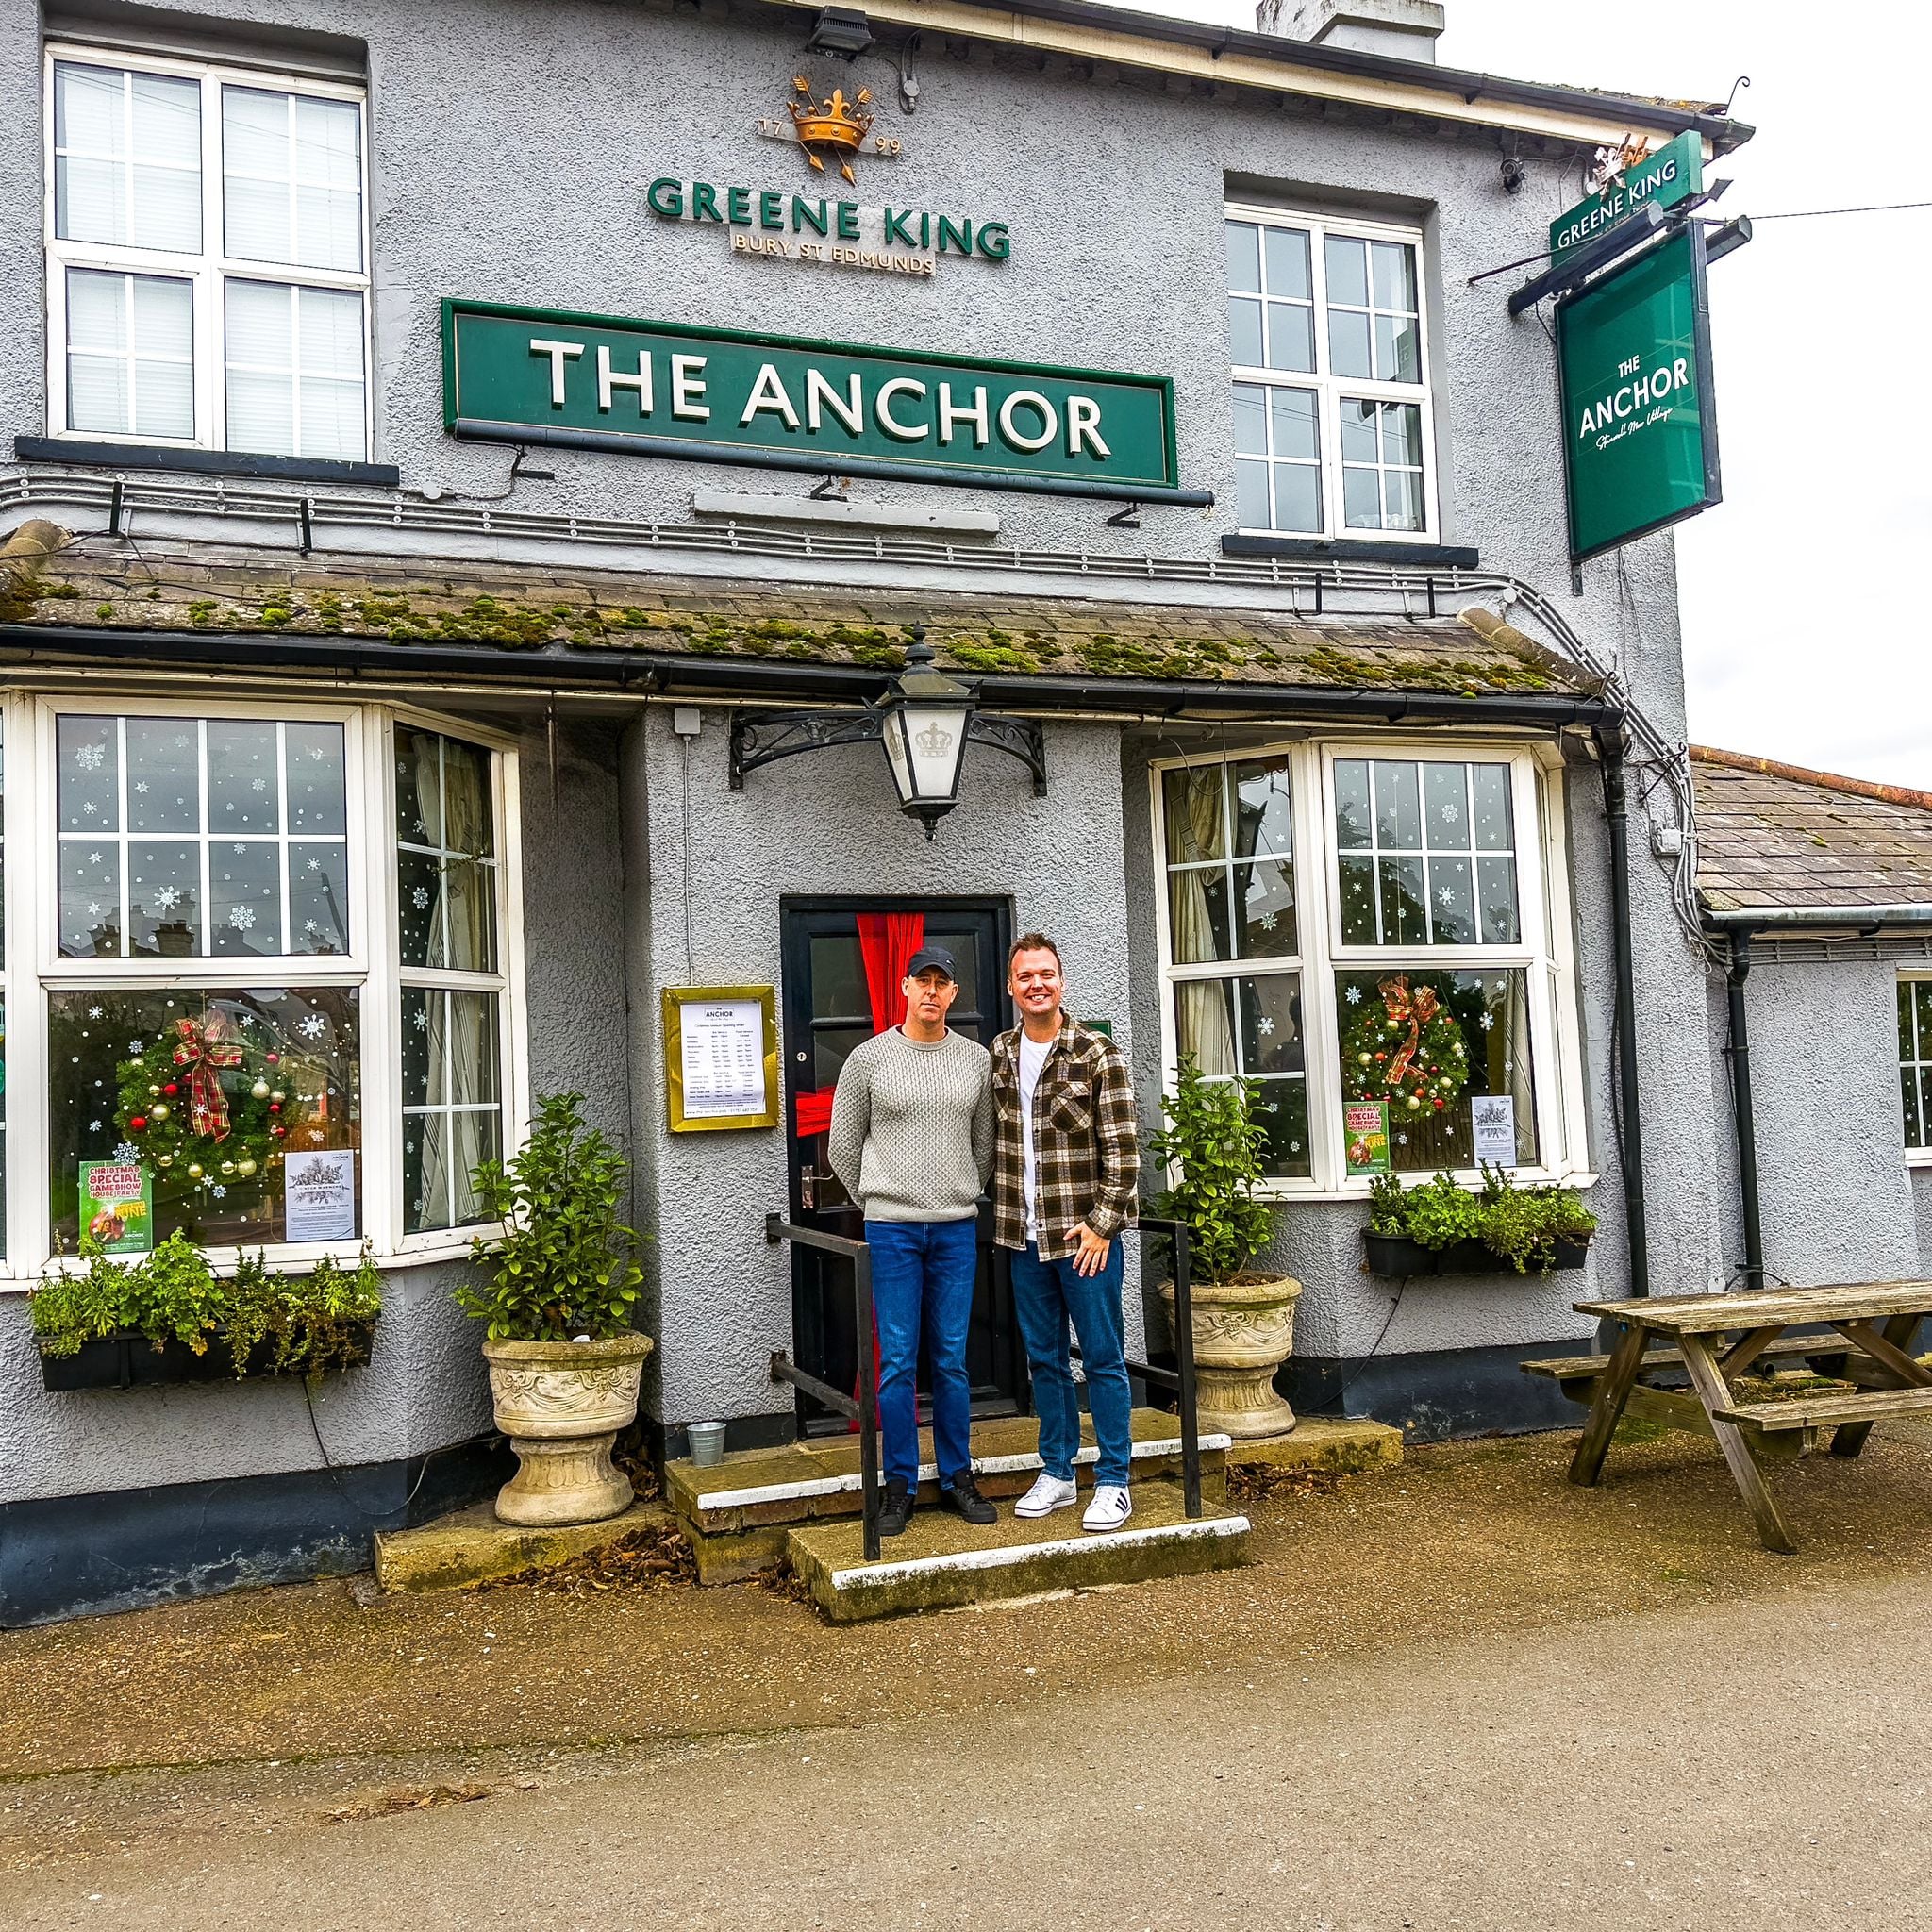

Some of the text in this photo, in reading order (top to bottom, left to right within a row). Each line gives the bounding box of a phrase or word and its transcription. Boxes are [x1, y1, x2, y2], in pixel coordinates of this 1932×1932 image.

[758, 119, 902, 155] 17 99
[647, 177, 1011, 259] GREENE KING
[1557, 193, 1624, 249] GREENE
[1628, 159, 1676, 206] KING
[733, 233, 934, 275] BURY ST EDMUNDS
[1617, 354, 1641, 379] THE
[529, 338, 1112, 458] THE ANCHOR
[1579, 358, 1690, 439] ANCHOR
[1347, 1112, 1380, 1121] SPECIAL
[90, 1166, 140, 1174] CHRISTMAS
[90, 1174, 140, 1184] SPECIAL
[90, 1183, 141, 1191] GAMESHOW
